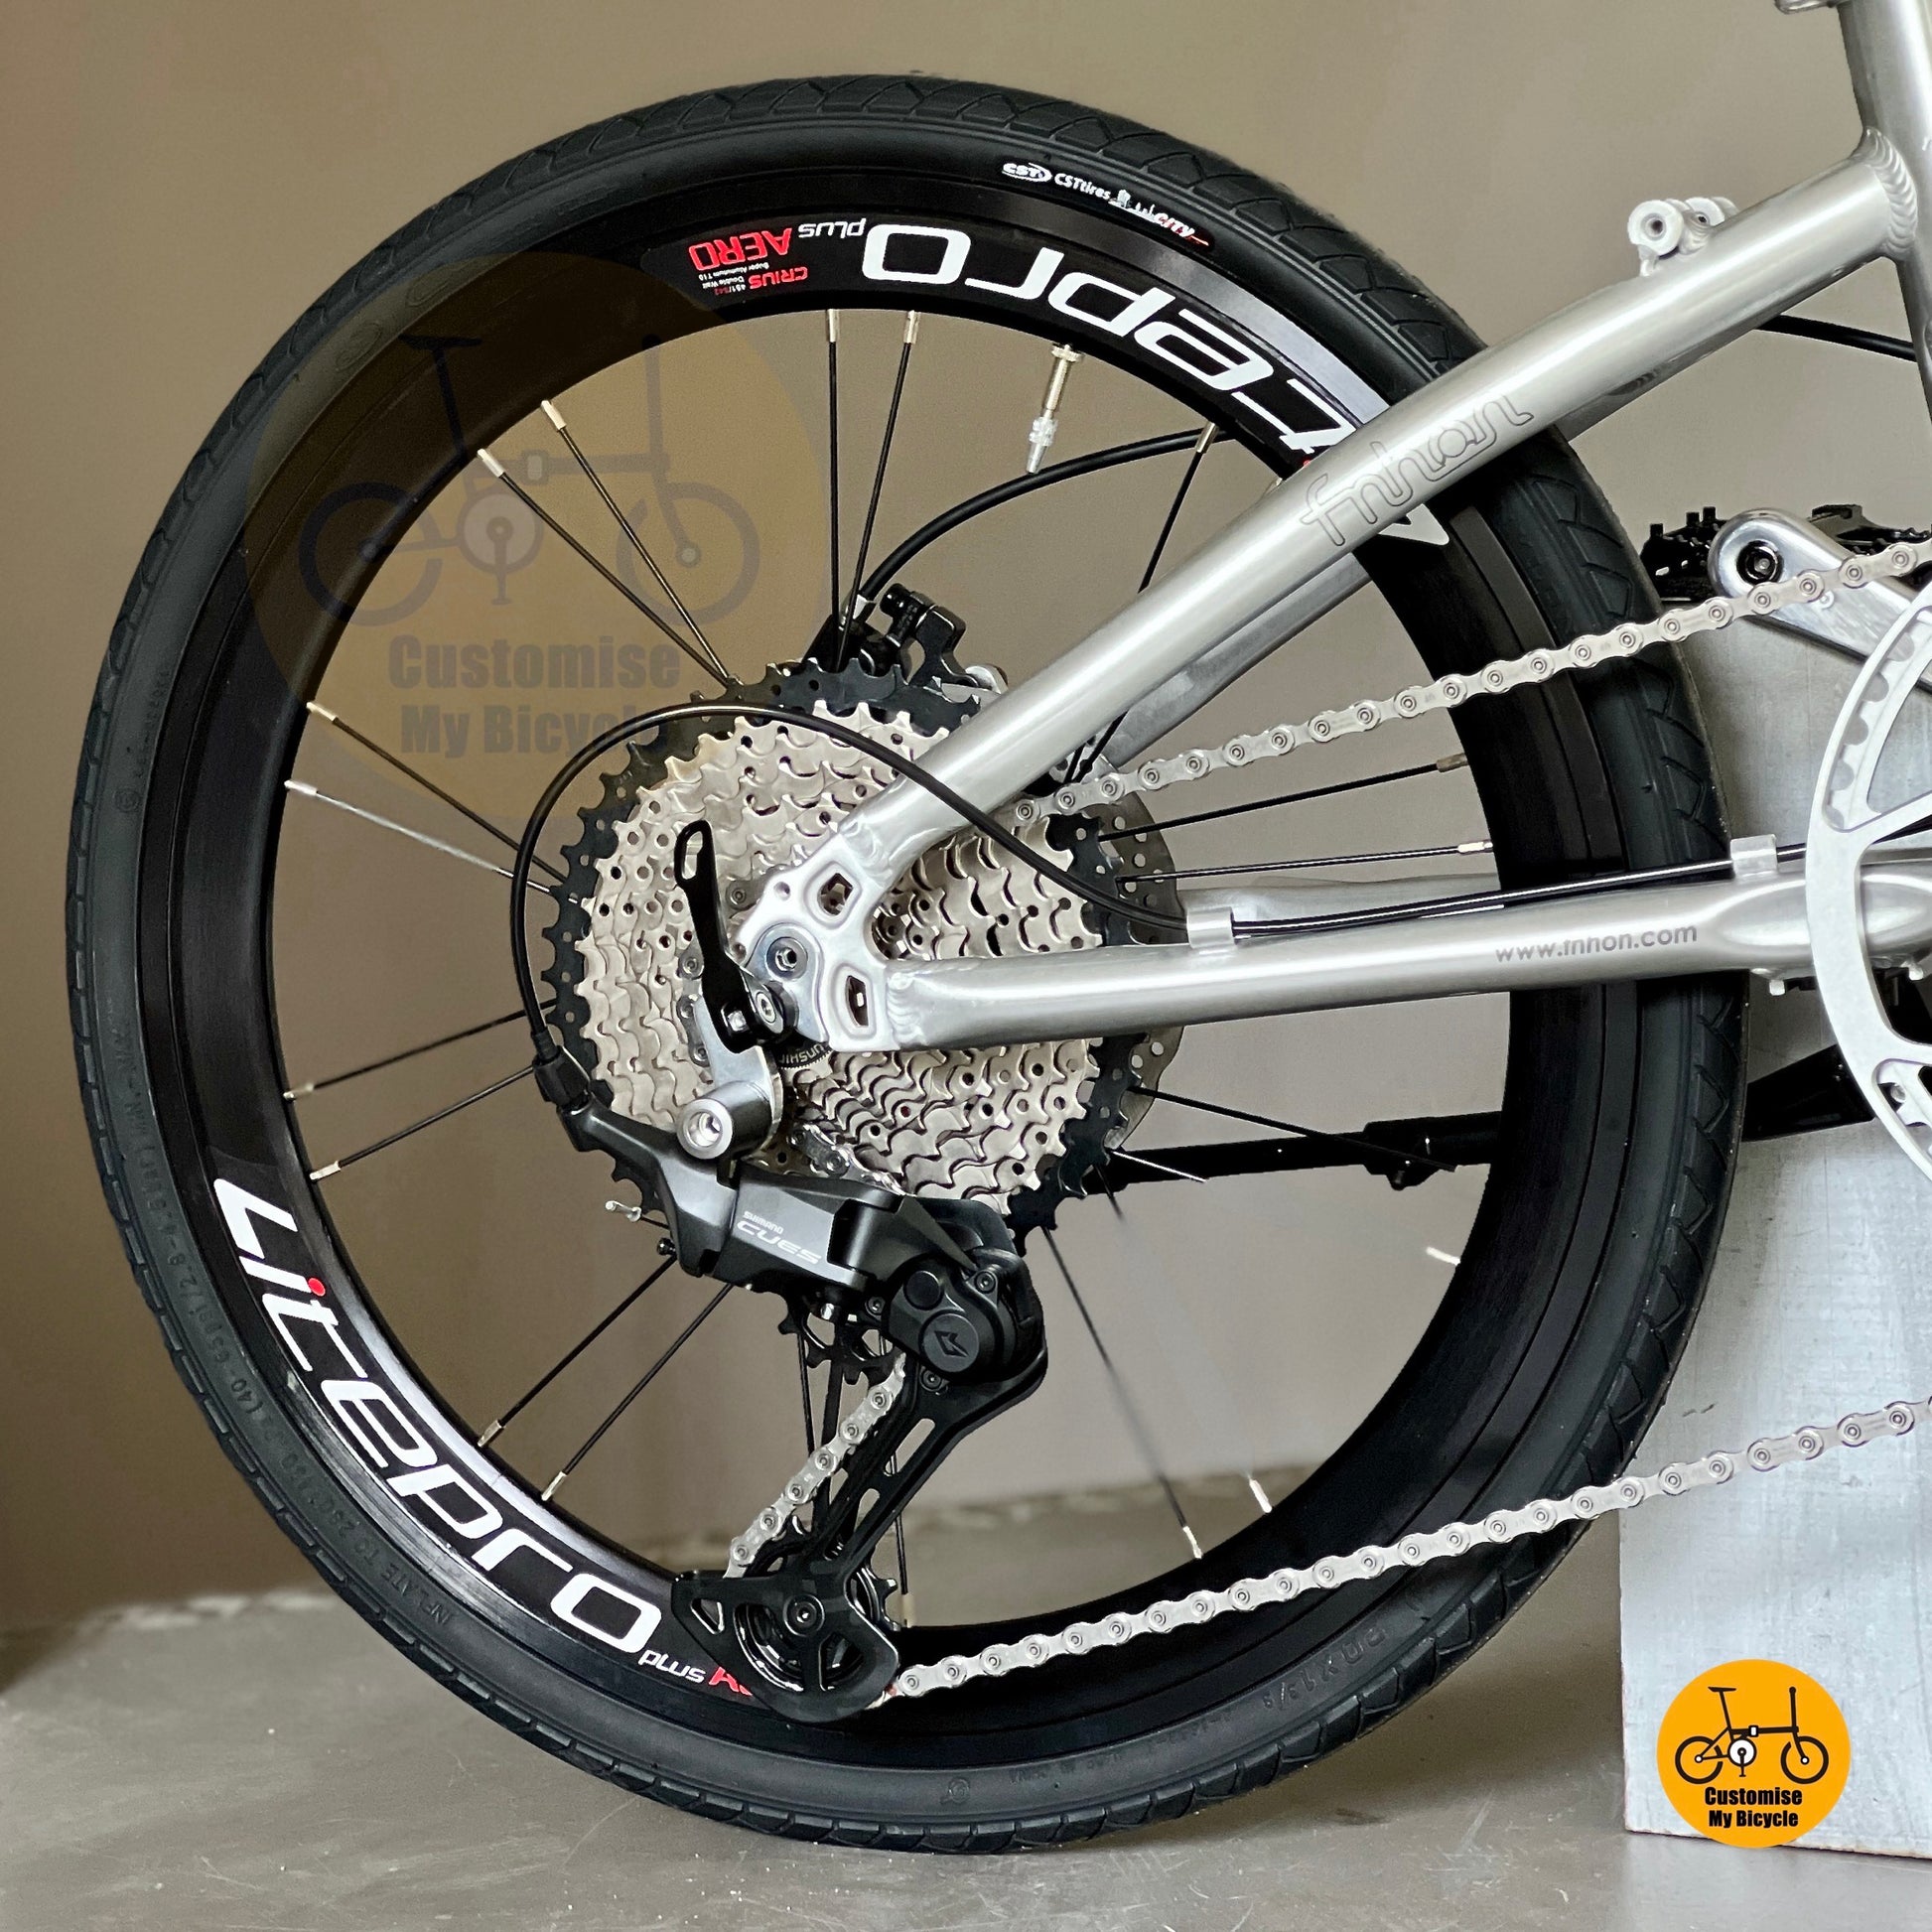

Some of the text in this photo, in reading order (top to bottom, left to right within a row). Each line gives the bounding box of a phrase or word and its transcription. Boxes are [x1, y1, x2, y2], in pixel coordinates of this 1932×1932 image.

[1154, 211, 1197, 240] CITY
[688, 227, 792, 271] AERO
[749, 266, 808, 290] CRIUS
[743, 1210, 784, 1235] SHIMANO
[737, 1220, 822, 1265] CUES
[213, 1177, 661, 1653] Litepro
